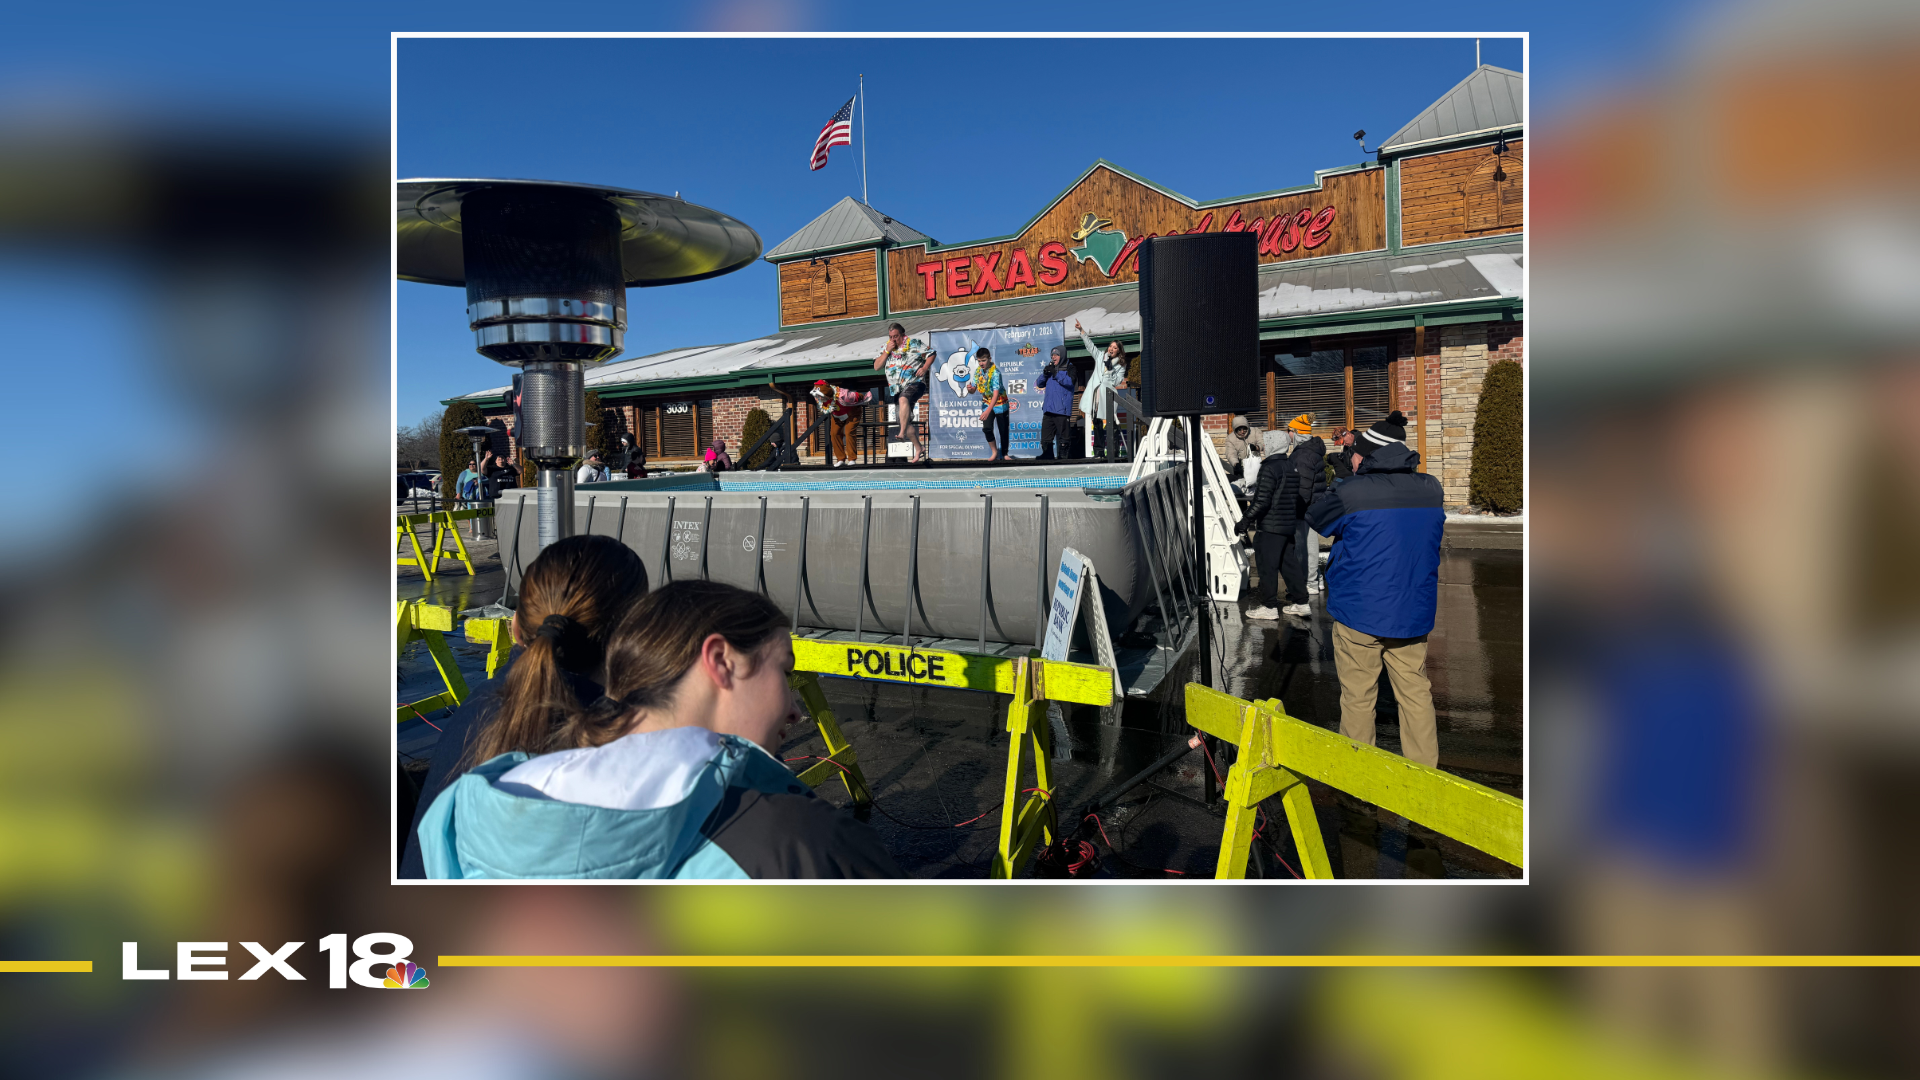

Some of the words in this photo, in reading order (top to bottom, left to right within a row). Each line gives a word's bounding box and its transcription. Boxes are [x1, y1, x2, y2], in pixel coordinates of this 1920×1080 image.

[916, 241, 1068, 300] TEXAS
[1005, 330, 1031, 339] February
[1040, 326, 1053, 336] 2026
[1019, 347, 1038, 356] TEXAS
[1009, 384, 1024, 394] 18
[667, 403, 688, 414] 3030
[939, 409, 982, 417] POLAR
[847, 648, 946, 681] POLICE
